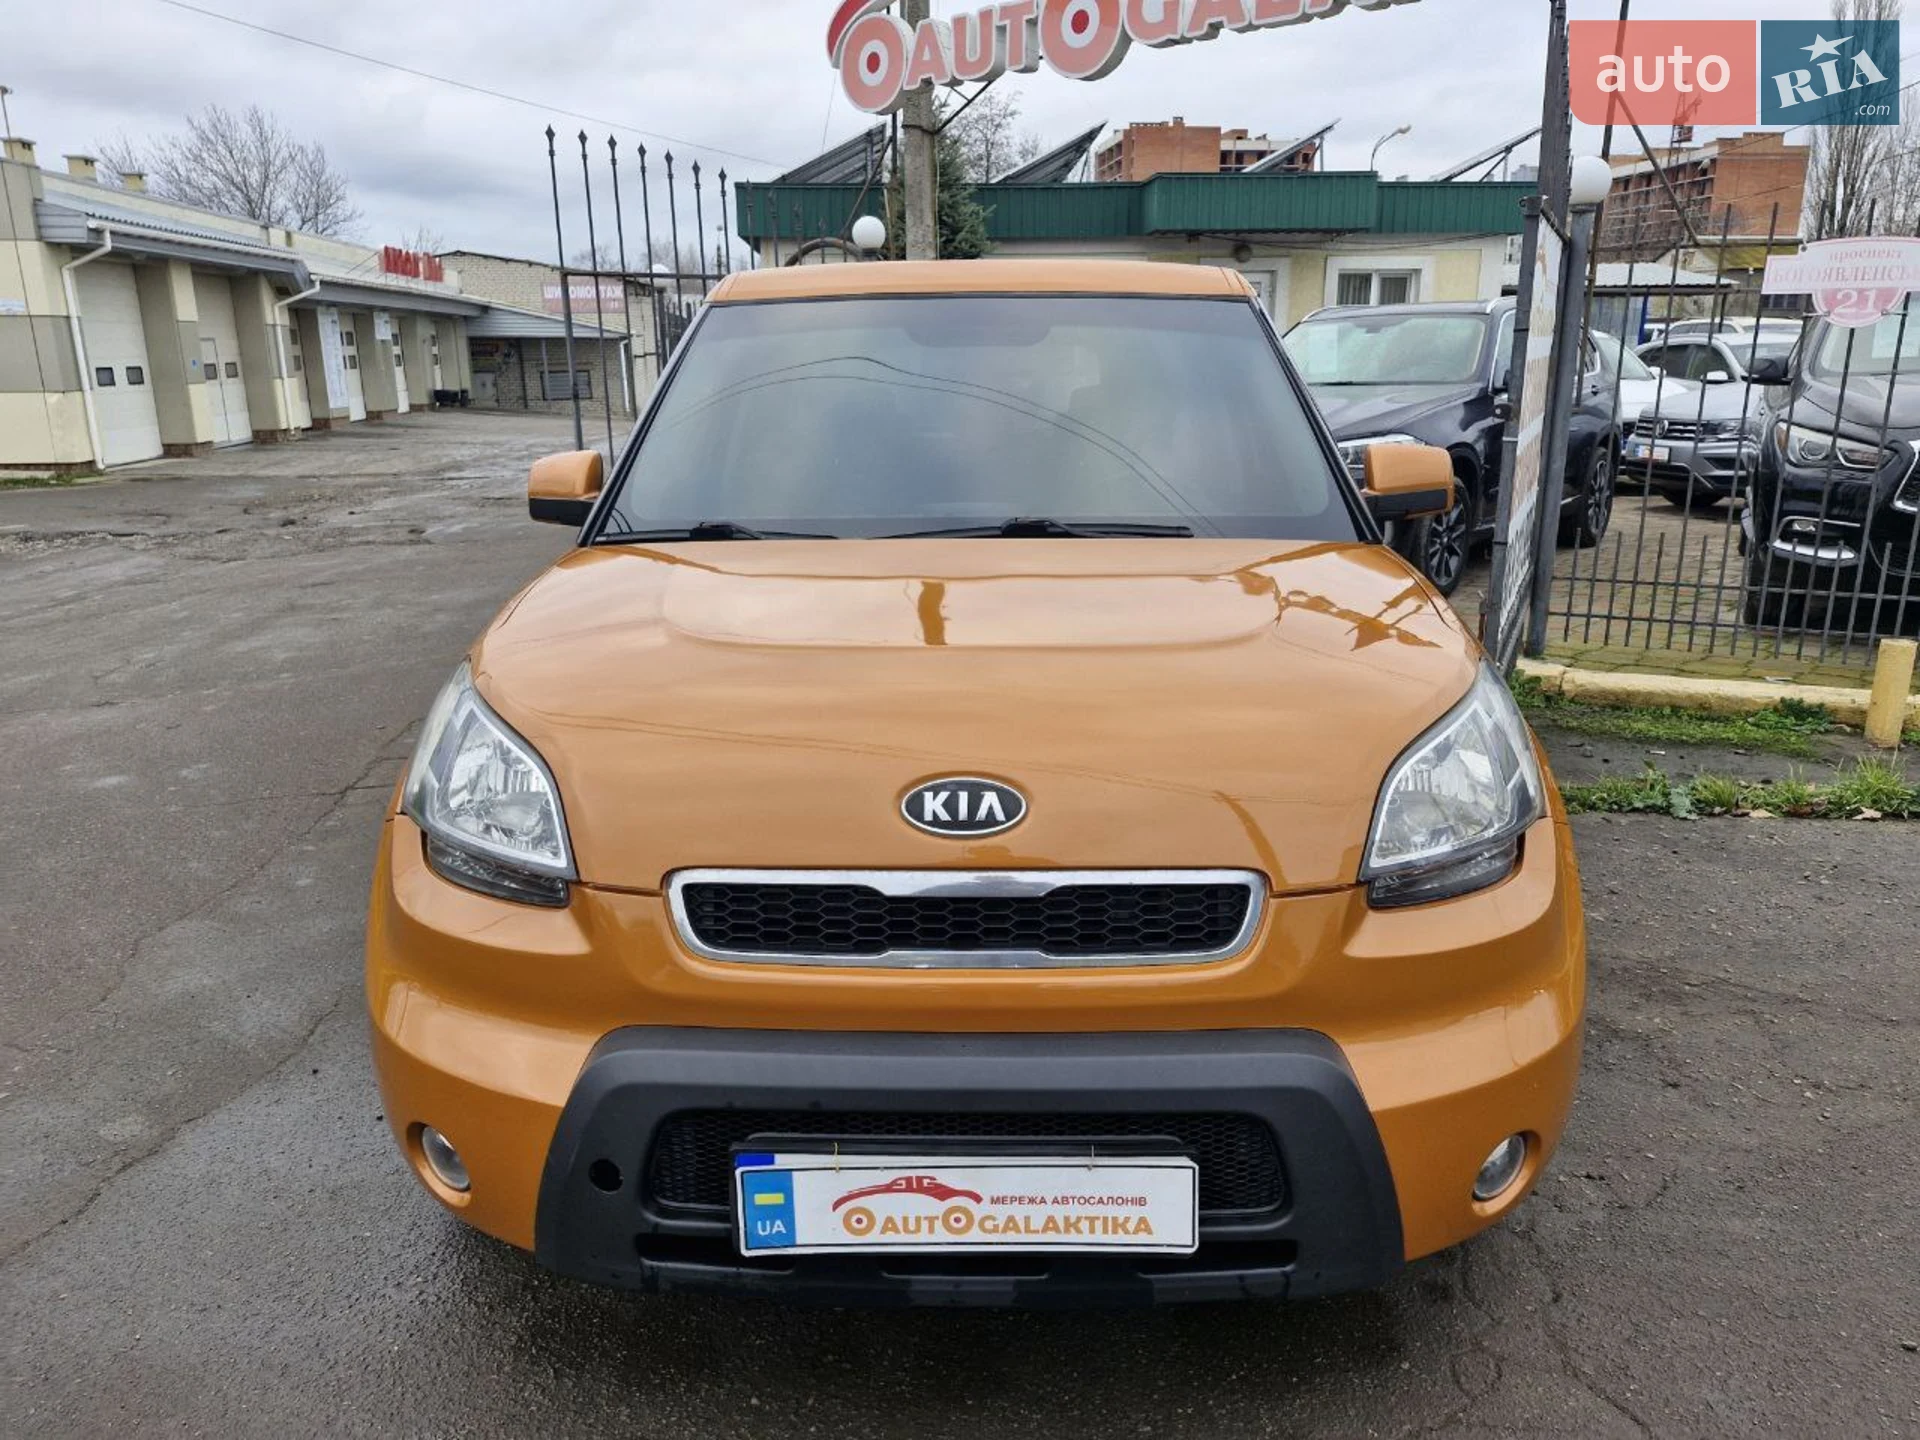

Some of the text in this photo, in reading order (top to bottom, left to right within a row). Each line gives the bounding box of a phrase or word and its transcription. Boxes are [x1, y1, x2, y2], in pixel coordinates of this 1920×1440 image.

[1834, 288, 1877, 313] 21
[922, 790, 1006, 822] KIA
[990, 1195, 1148, 1207] МЕРЕЖА АВТОСАЛОНІВ
[757, 1219, 787, 1236] UA
